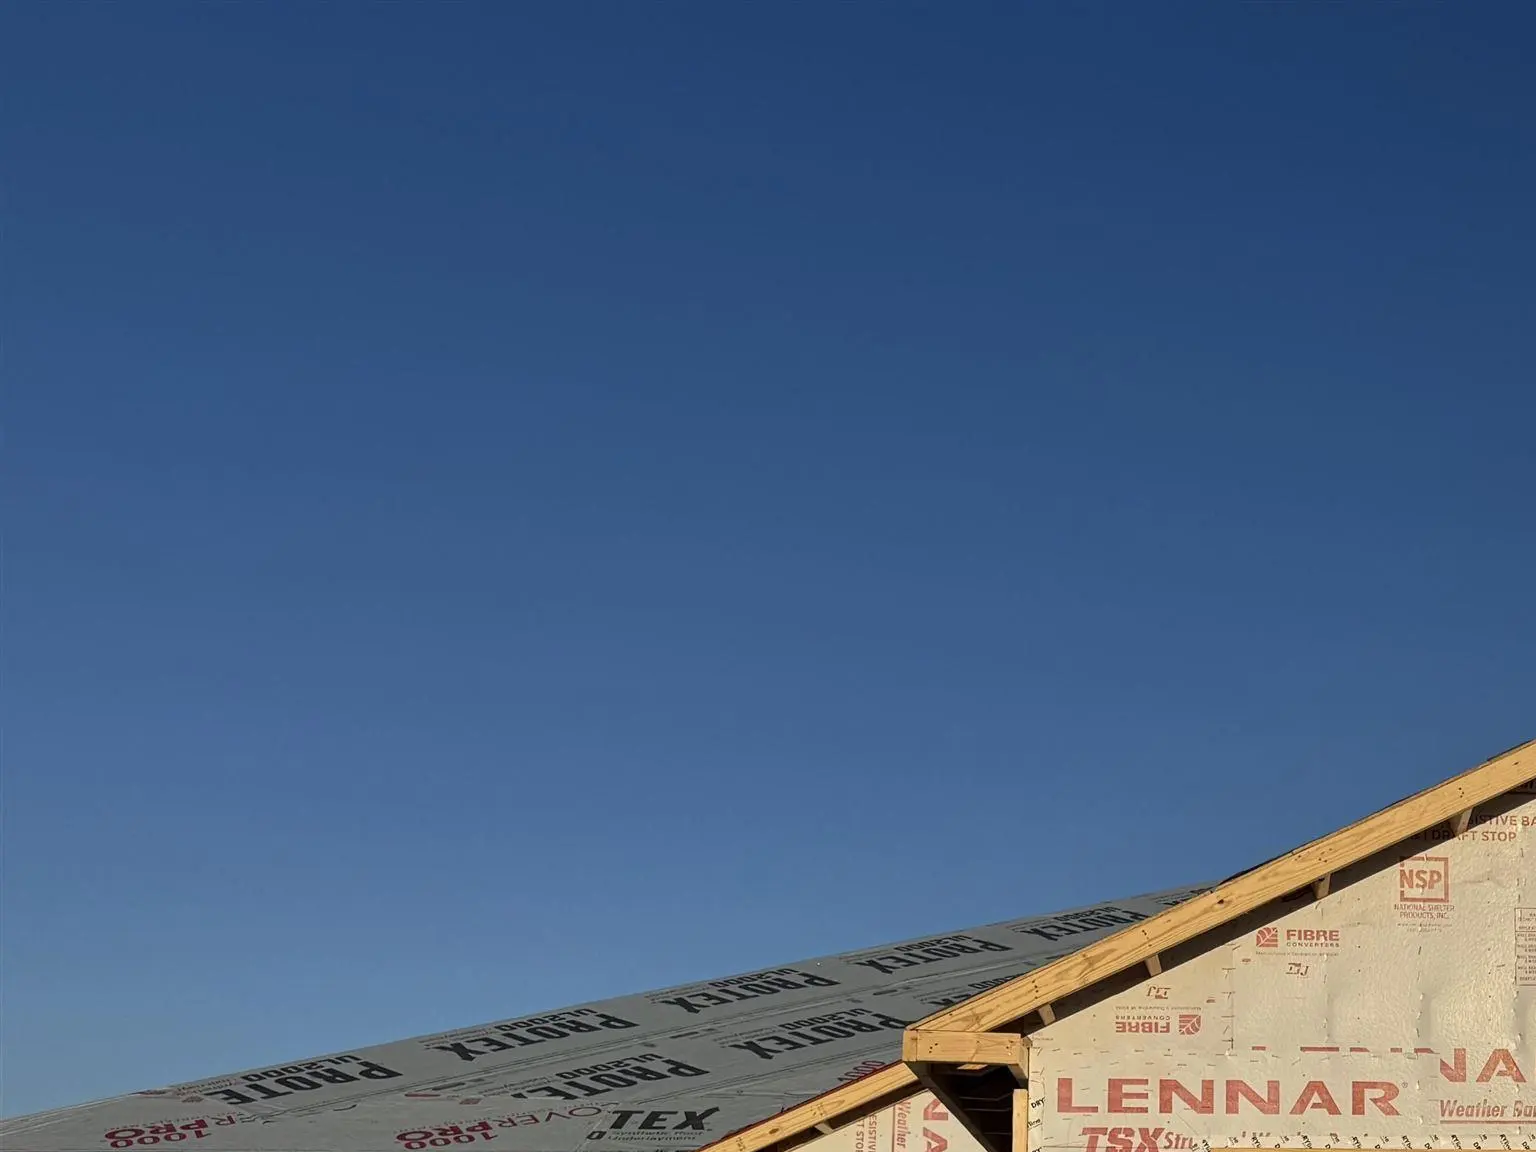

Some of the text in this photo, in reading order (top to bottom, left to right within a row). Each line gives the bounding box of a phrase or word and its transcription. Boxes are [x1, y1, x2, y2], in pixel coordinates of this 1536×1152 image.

[1481, 830, 1516, 842] STOP
[1400, 869, 1442, 891] NSP
[1286, 929, 1340, 942] FIBRE
[854, 936, 1013, 975] PROTEX
[659, 972, 840, 1014] PROTEX
[491, 1008, 596, 1032] UL2000
[778, 1007, 872, 1031] UL2000
[1115, 1022, 1171, 1033] FIBRE
[432, 1013, 639, 1061] PROTEX
[727, 1012, 907, 1060] PROTEX
[510, 1057, 709, 1101] PROTE
[556, 1053, 664, 1080] UL2000
[1056, 1078, 1401, 1116] LENNAR
[1439, 1100, 1506, 1118] Weather
[607, 1107, 719, 1131] TEX
[896, 1102, 911, 1147] Weather
